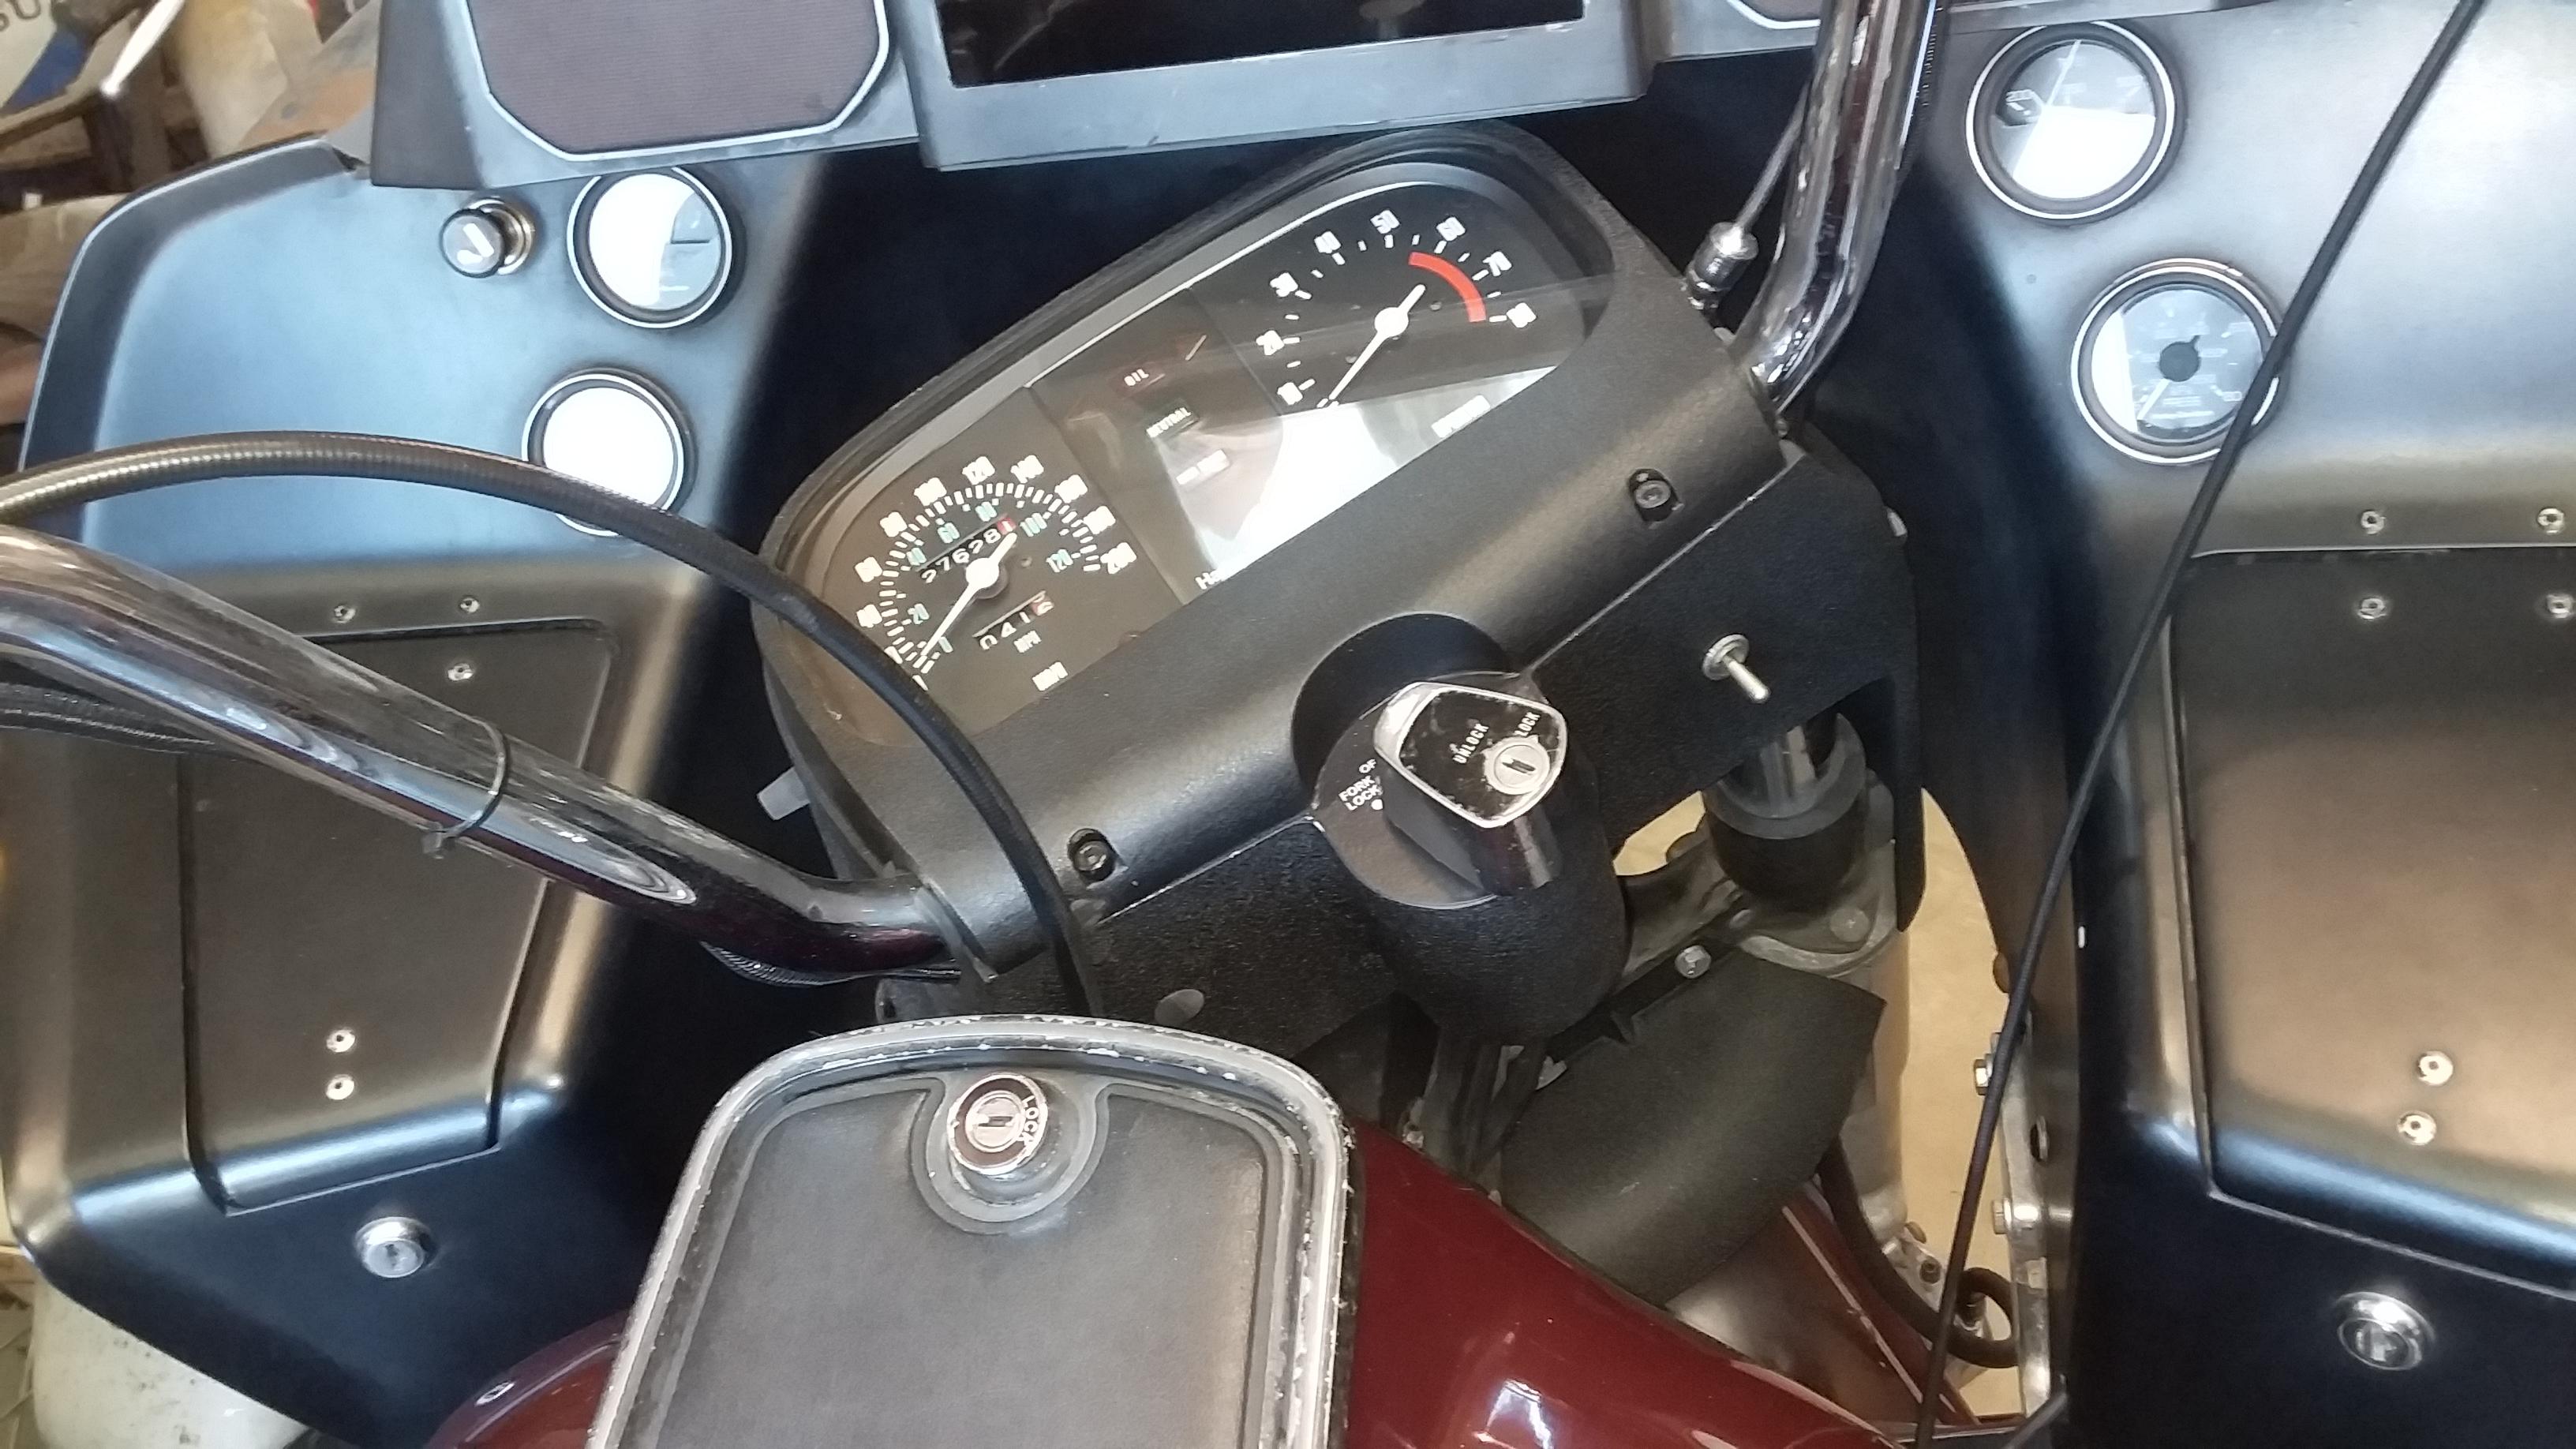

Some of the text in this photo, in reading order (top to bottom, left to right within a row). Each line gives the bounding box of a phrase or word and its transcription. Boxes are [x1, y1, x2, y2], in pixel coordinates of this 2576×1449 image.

[1370, 209, 1400, 234] 50
[1482, 251, 1512, 277] 70
[1124, 368, 1149, 387] OIL
[1046, 549, 1074, 573] 120
[1515, 711, 1541, 737] LOCK
[1452, 723, 1490, 765] UNLOCK
[1358, 758, 1377, 773] OF
[1338, 775, 1376, 802] FORK
[1345, 784, 1383, 811] LOCK
